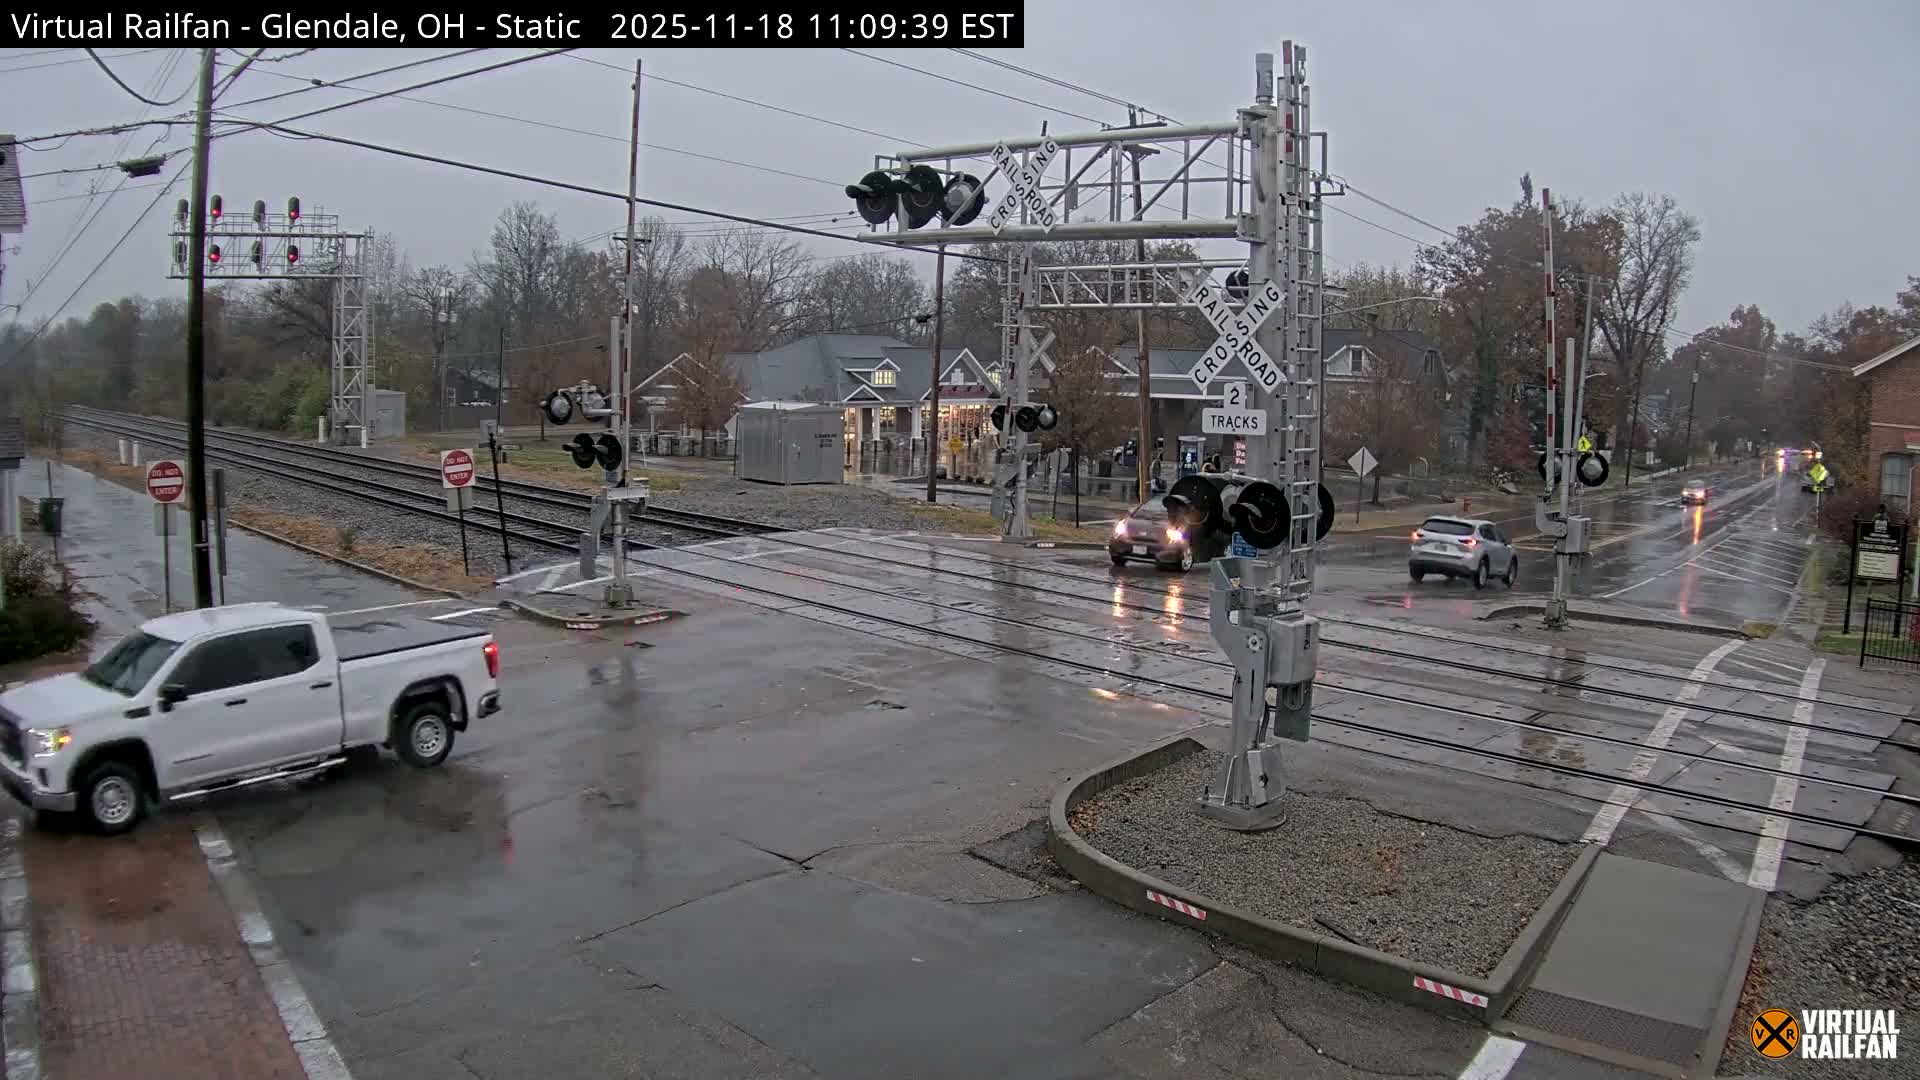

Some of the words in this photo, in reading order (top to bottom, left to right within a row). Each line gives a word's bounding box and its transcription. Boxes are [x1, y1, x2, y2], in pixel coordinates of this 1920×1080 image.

[990, 140, 1055, 229] CROSSING
[1194, 286, 1279, 384] CROSSING
[1211, 415, 1258, 430] TRACKS
[1229, 388, 1240, 405] 2
